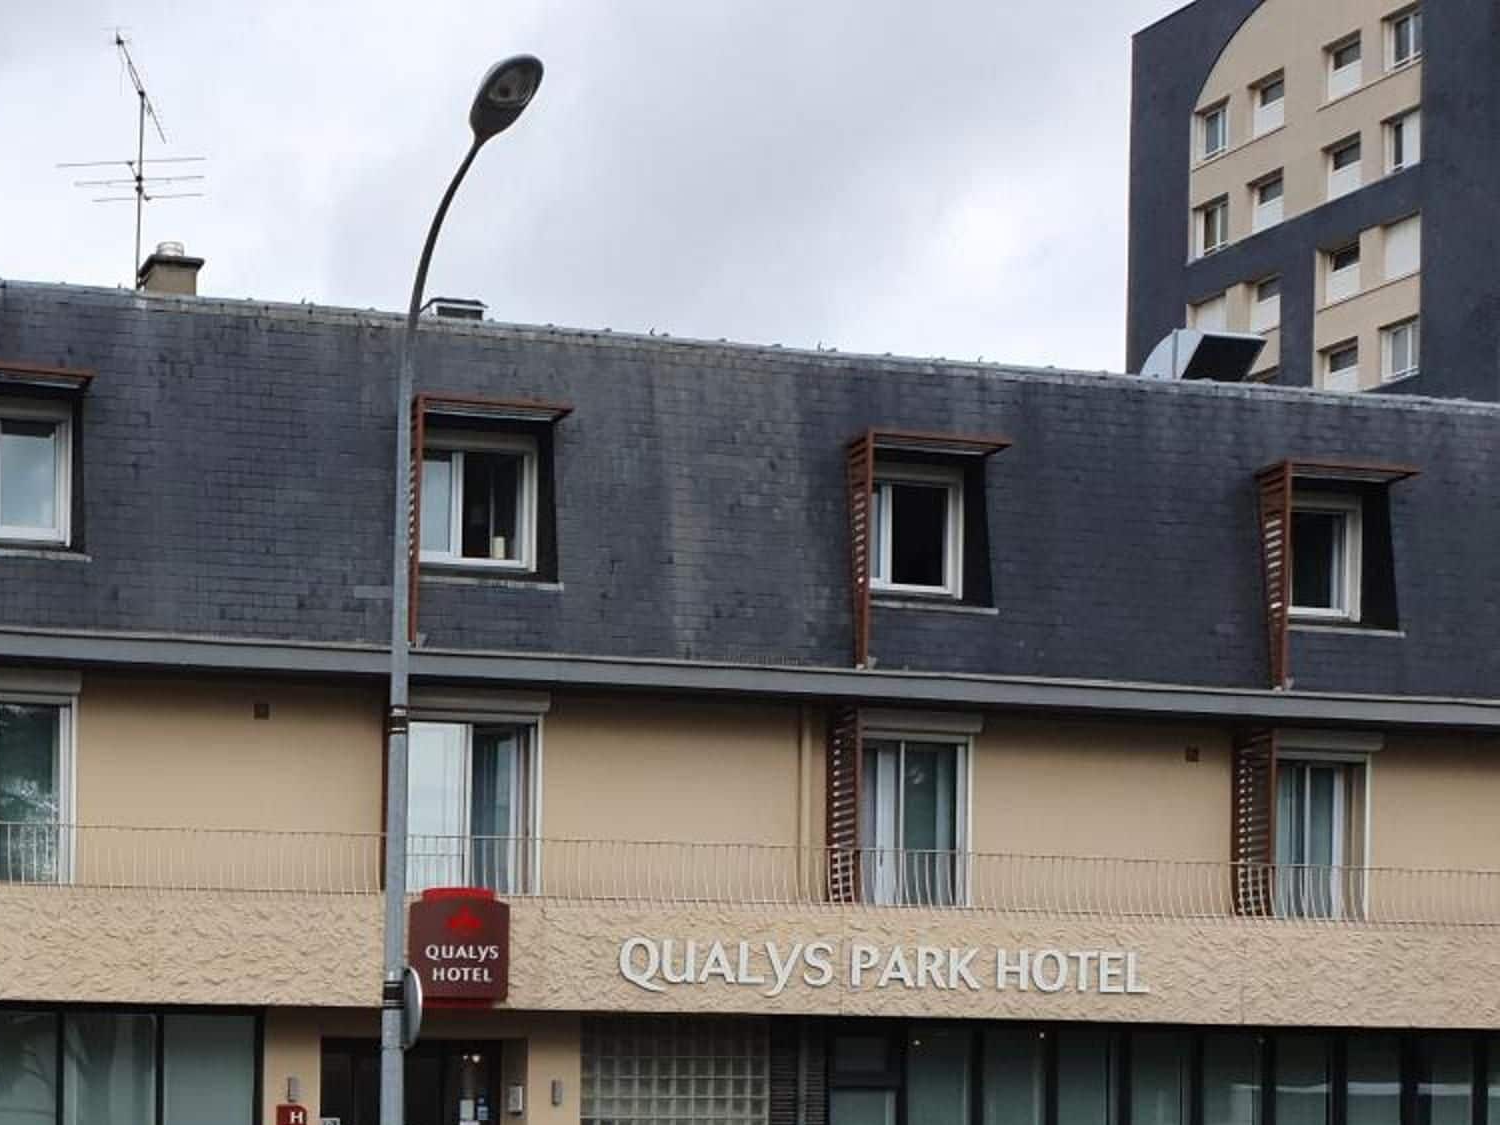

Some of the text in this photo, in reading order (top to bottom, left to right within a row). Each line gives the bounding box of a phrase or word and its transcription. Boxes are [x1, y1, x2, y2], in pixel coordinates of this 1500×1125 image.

[432, 967, 493, 982] HOTEL
[850, 945, 980, 990] PARK
[996, 948, 1150, 994] HOTEL
[290, 1111, 303, 1124] H
